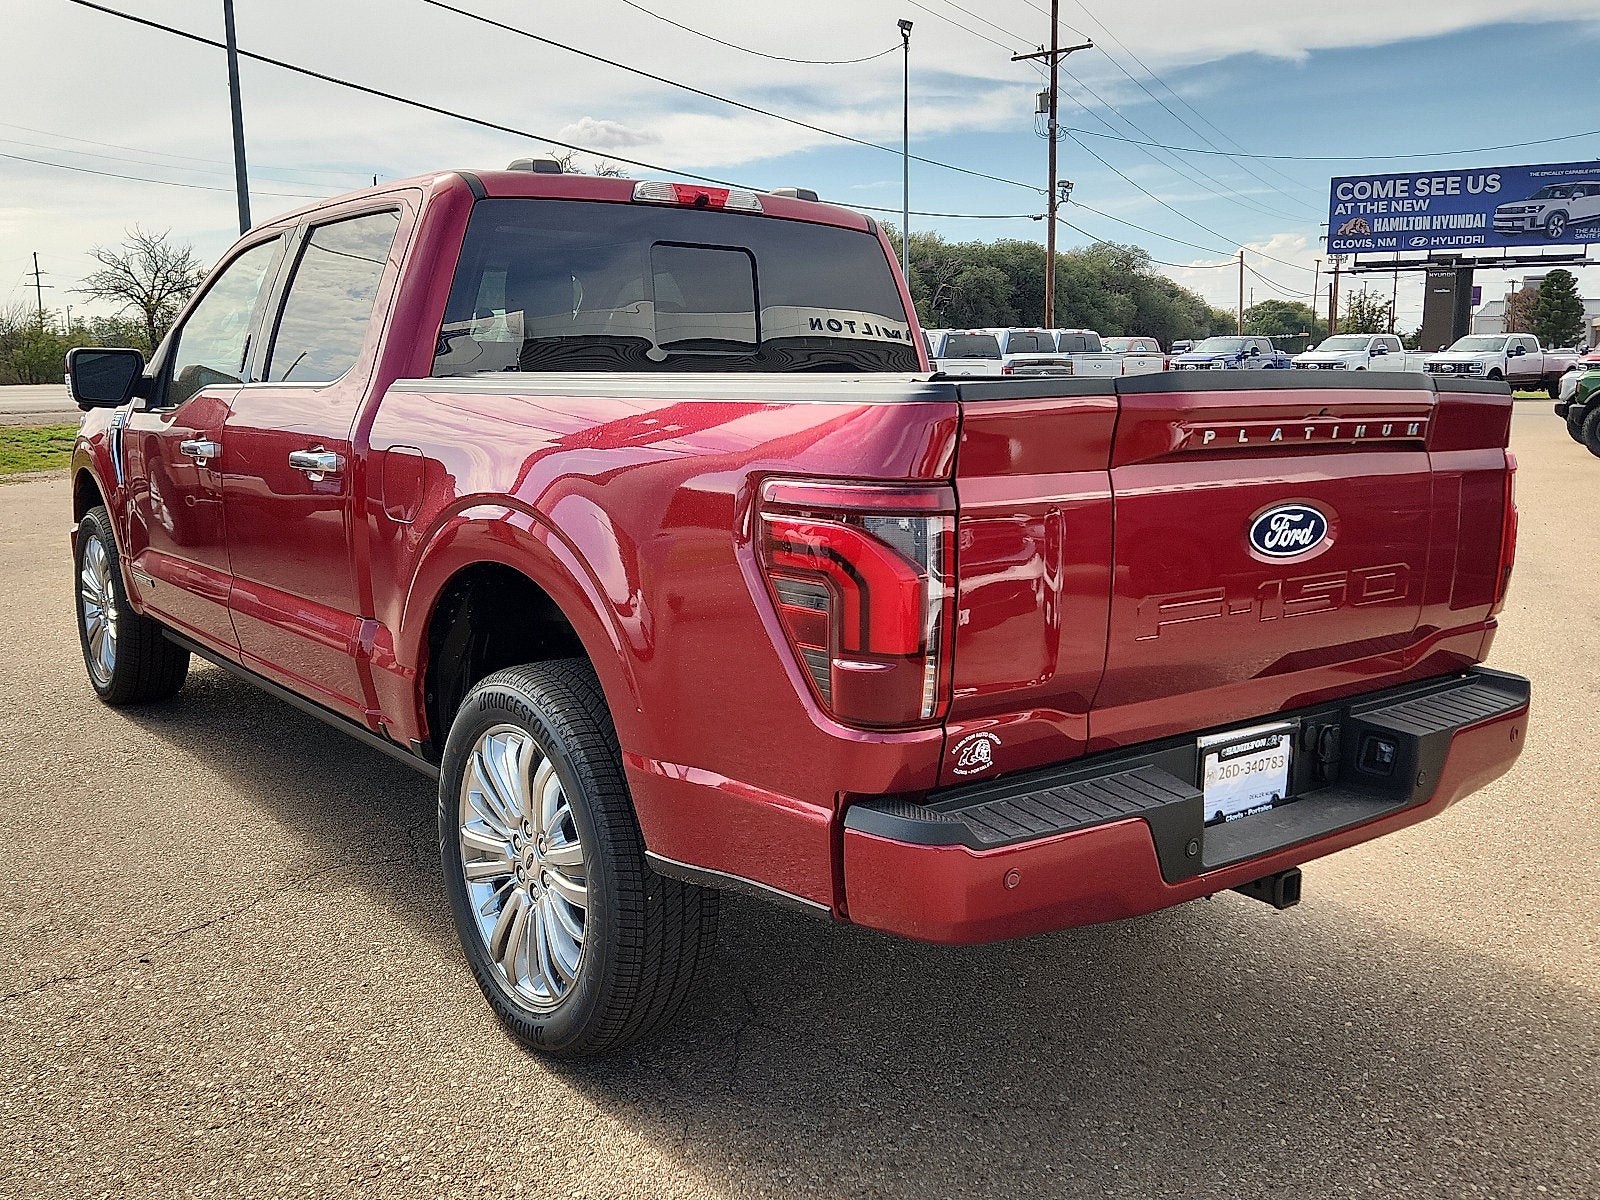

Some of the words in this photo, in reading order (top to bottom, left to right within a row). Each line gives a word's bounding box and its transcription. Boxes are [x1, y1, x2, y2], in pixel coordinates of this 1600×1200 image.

[1336, 179, 1410, 201] COME
[1414, 176, 1462, 197] SEE
[1466, 173, 1501, 194] US
[1334, 202, 1355, 216] AT
[1357, 200, 1388, 214] THE
[1391, 198, 1430, 213] NEW
[1373, 214, 1431, 233] HAMILTON
[1432, 213, 1487, 230] HYUNDAI
[1332, 237, 1375, 249] CLOVIS,
[1377, 236, 1397, 247] NM
[1431, 235, 1485, 246] HYUNDAI
[1203, 422, 1420, 445] PLATINUM
[1263, 511, 1317, 550] Ford
[1134, 562, 1411, 641] F-150
[478, 690, 559, 758] BRIDGESTONE
[1218, 755, 1285, 781] 26D-340783
